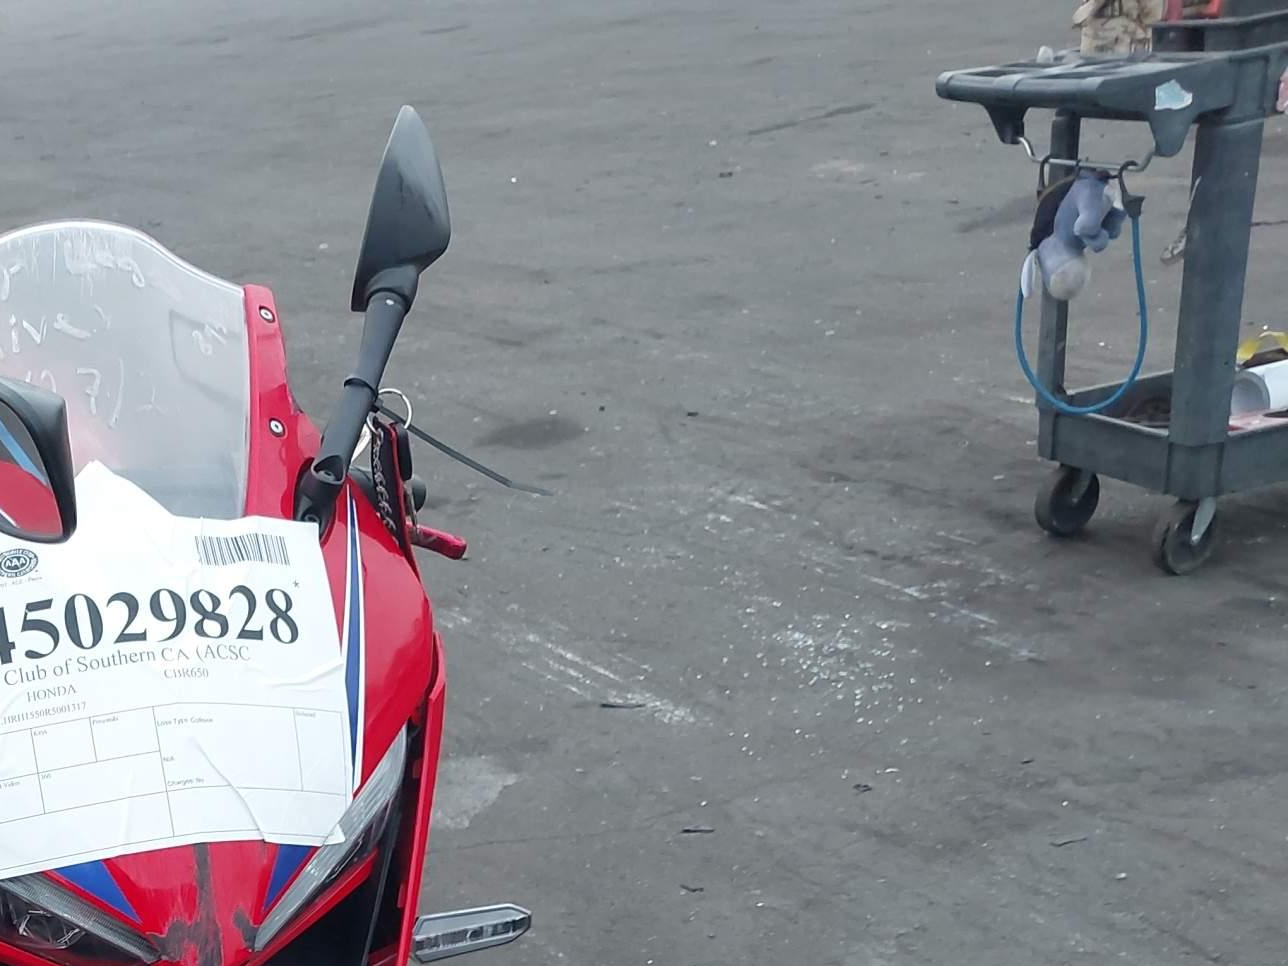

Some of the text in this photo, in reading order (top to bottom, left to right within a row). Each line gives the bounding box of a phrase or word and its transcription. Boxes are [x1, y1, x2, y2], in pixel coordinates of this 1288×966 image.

[4, 664, 47, 686] Club
[53, 658, 72, 677] of
[77, 650, 156, 672] Southern
[161, 647, 190, 662] CA
[196, 644, 251, 663] (ACSC
[27, 684, 77, 702] HONDA
